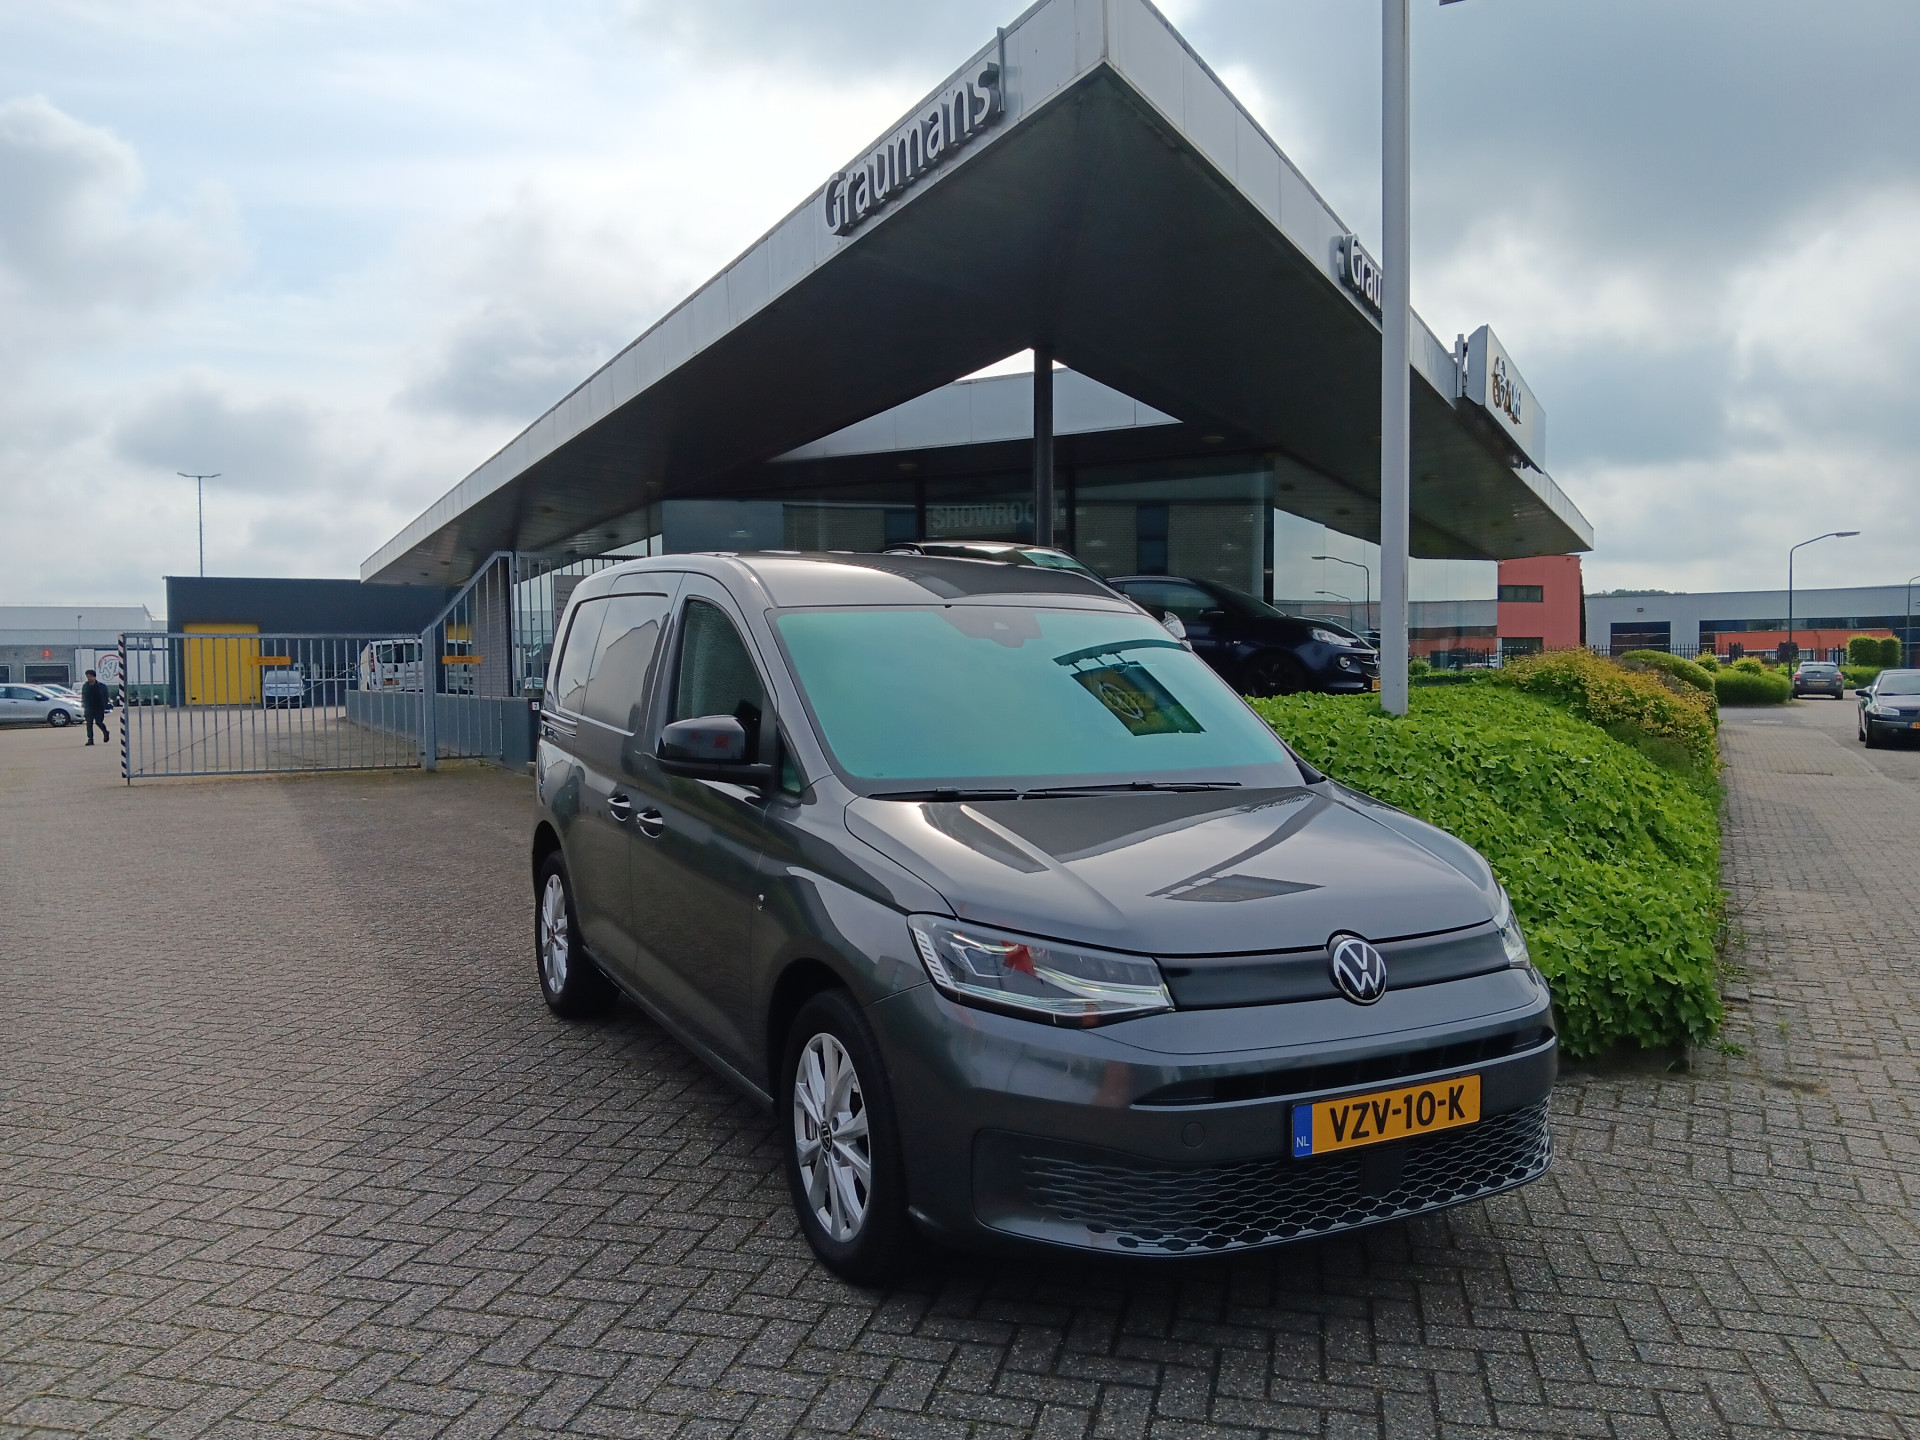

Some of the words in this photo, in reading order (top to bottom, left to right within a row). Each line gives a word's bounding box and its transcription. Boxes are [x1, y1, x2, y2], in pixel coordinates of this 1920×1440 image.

[825, 62, 1001, 235] Graumans
[1344, 233, 1382, 310] Grau
[932, 501, 1059, 529] SHOWROO
[1296, 1136, 1310, 1149] NL
[1329, 1084, 1466, 1143] VZV-10-K
